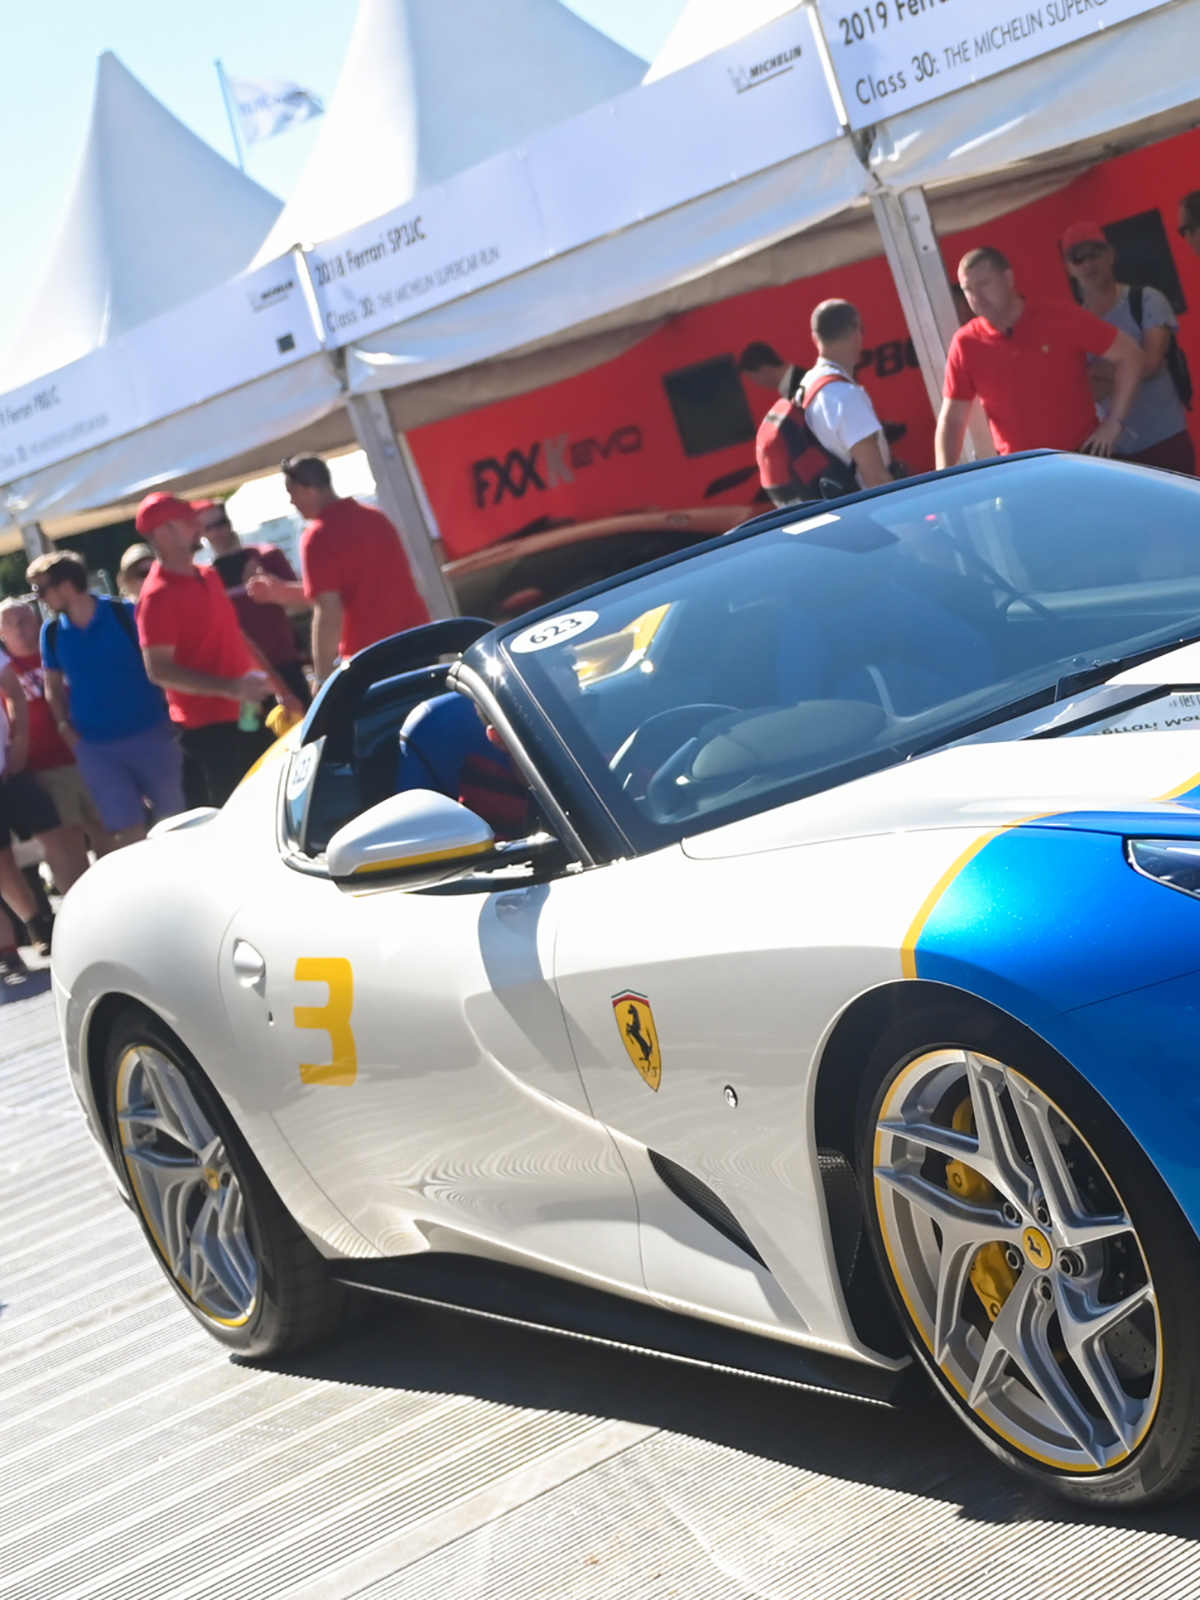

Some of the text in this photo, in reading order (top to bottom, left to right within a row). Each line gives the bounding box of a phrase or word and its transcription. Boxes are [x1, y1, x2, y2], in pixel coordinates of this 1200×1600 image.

[838, 0, 947, 46] 2019 Ferr
[750, 45, 802, 78] MICHELIN
[855, 0, 1108, 105] Class 30: THE MICHELIN SUPER
[314, 254, 346, 287] 2018
[346, 232, 389, 273] Ferrari
[325, 309, 358, 333] Class
[529, 618, 583, 645] 623
[293, 956, 358, 1087] 3
